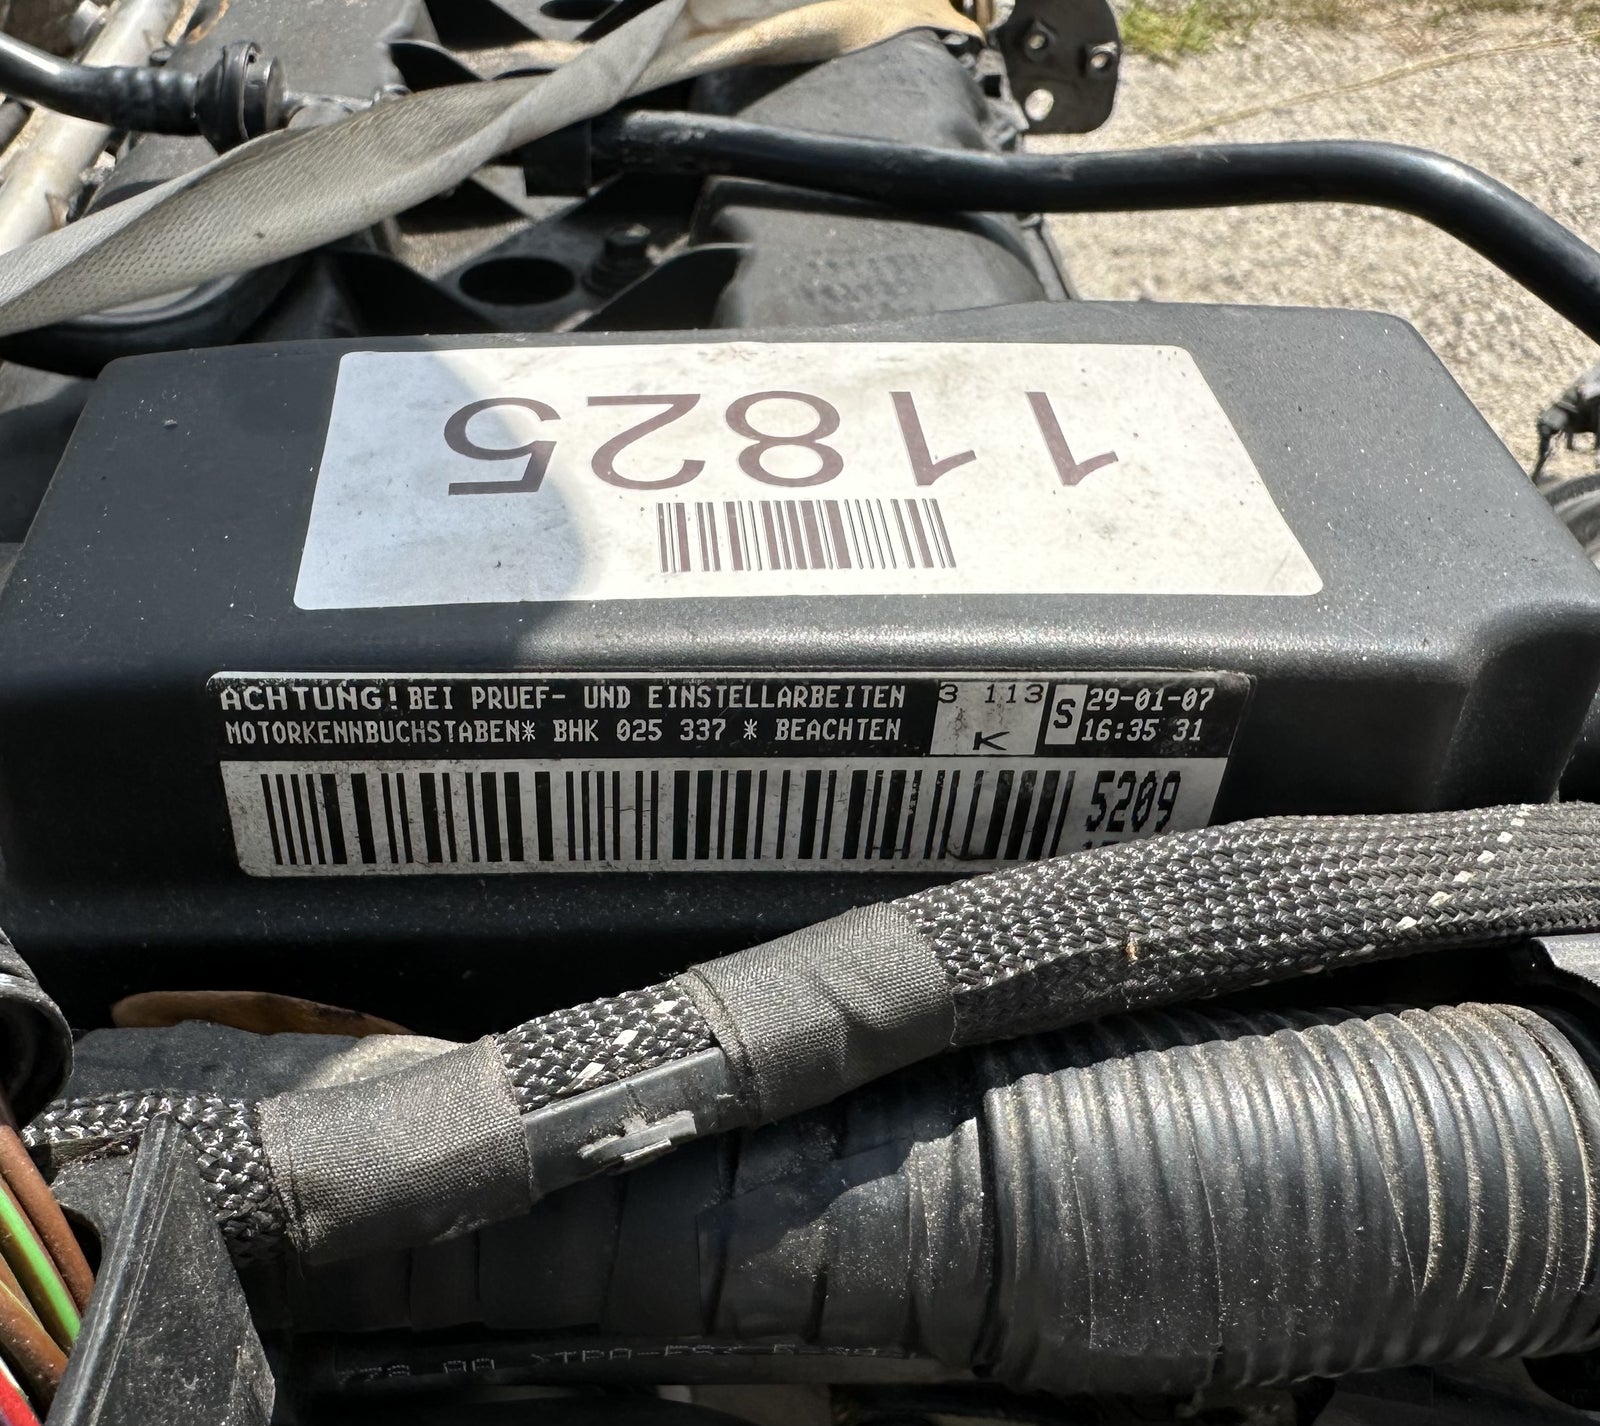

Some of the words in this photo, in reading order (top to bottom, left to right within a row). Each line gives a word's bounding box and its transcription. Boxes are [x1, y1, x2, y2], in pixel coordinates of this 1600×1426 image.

[443, 391, 1119, 496] 11825
[220, 686, 398, 711] ACHTUNG!
[408, 686, 454, 710] BEI
[472, 685, 566, 710] PRUEF-
[584, 685, 631, 709] UND
[648, 685, 906, 709] EINSTELLARBEITEN
[984, 683, 1045, 704] 113
[1086, 687, 1215, 711] 29-01-07
[1053, 699, 1076, 729] S
[553, 719, 600, 743] BHK
[616, 718, 663, 742] 025
[680, 718, 727, 742] 337
[774, 718, 901, 742] BEACHTEN
[973, 731, 1010, 751] K
[1084, 770, 1181, 833] 5209
